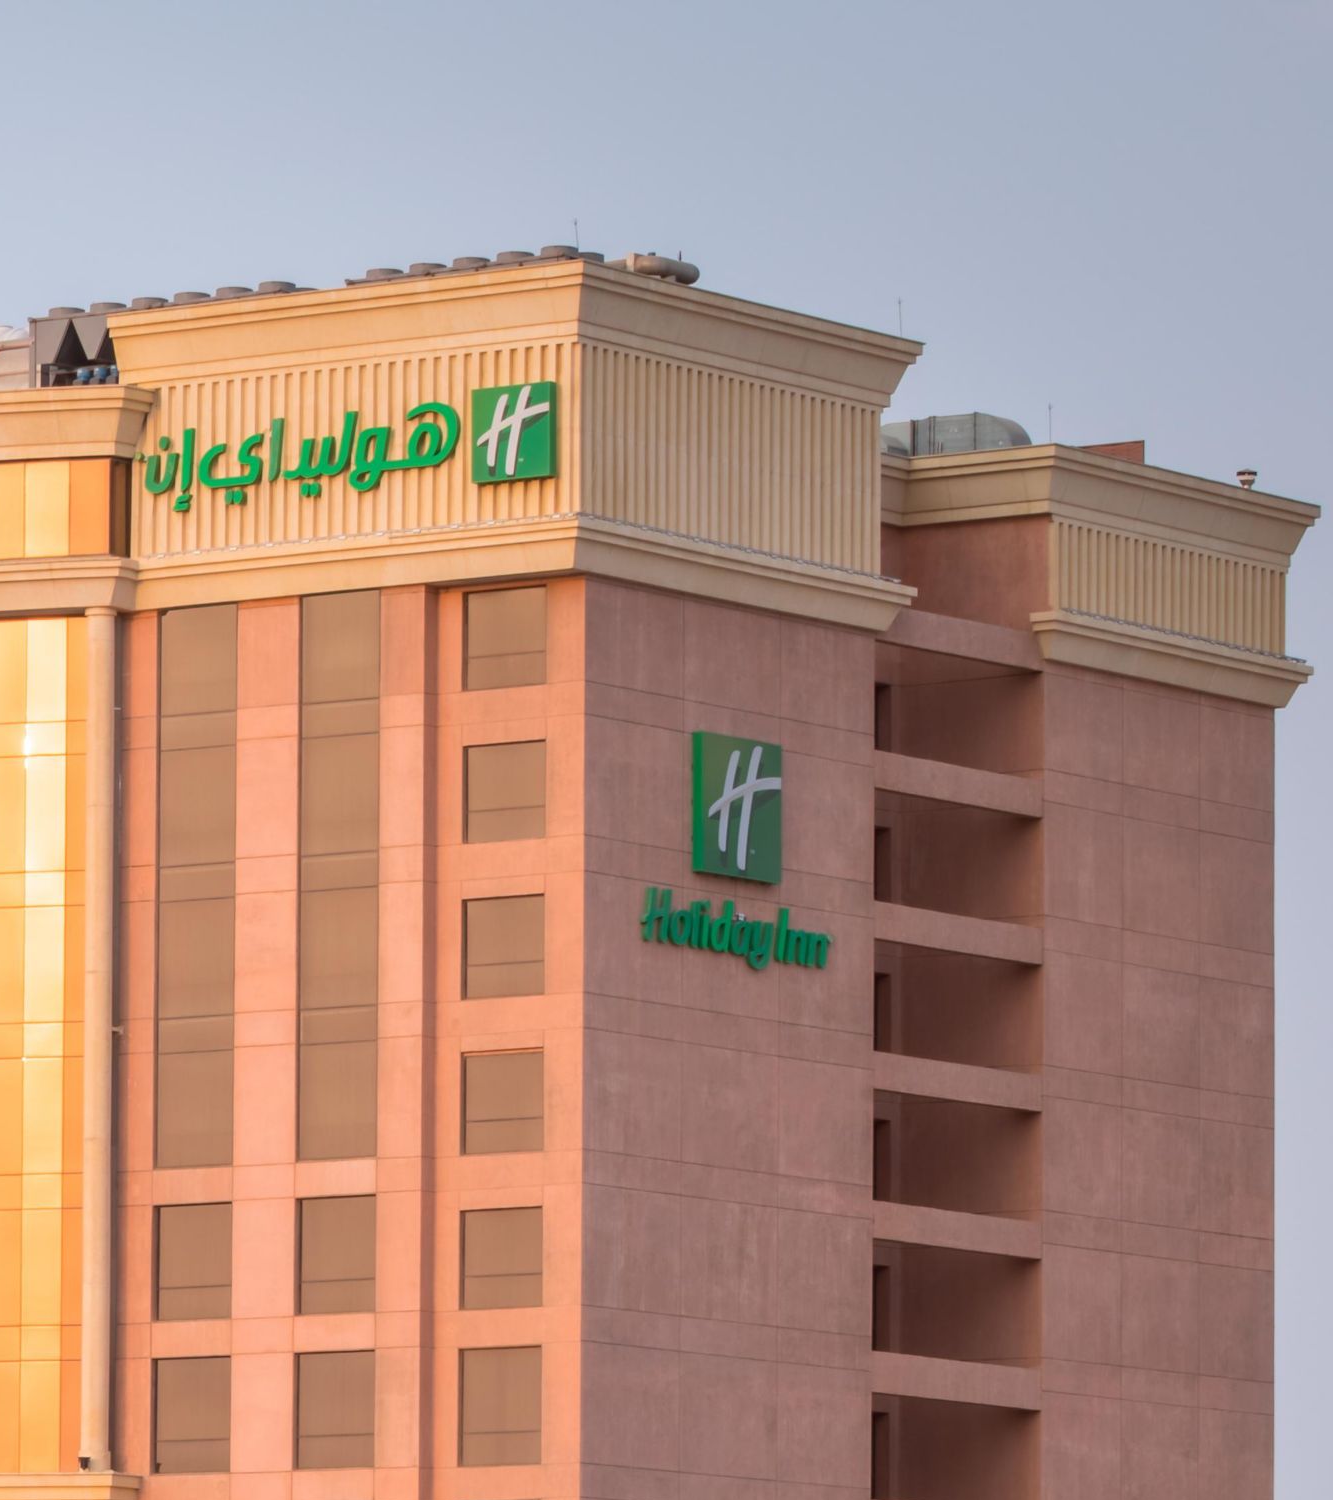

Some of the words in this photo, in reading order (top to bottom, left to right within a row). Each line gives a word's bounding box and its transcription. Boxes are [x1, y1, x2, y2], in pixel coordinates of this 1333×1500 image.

[198, 402, 461, 505] هوليداي
[641, 887, 774, 970] Holiday
[774, 907, 831, 969] Inn
